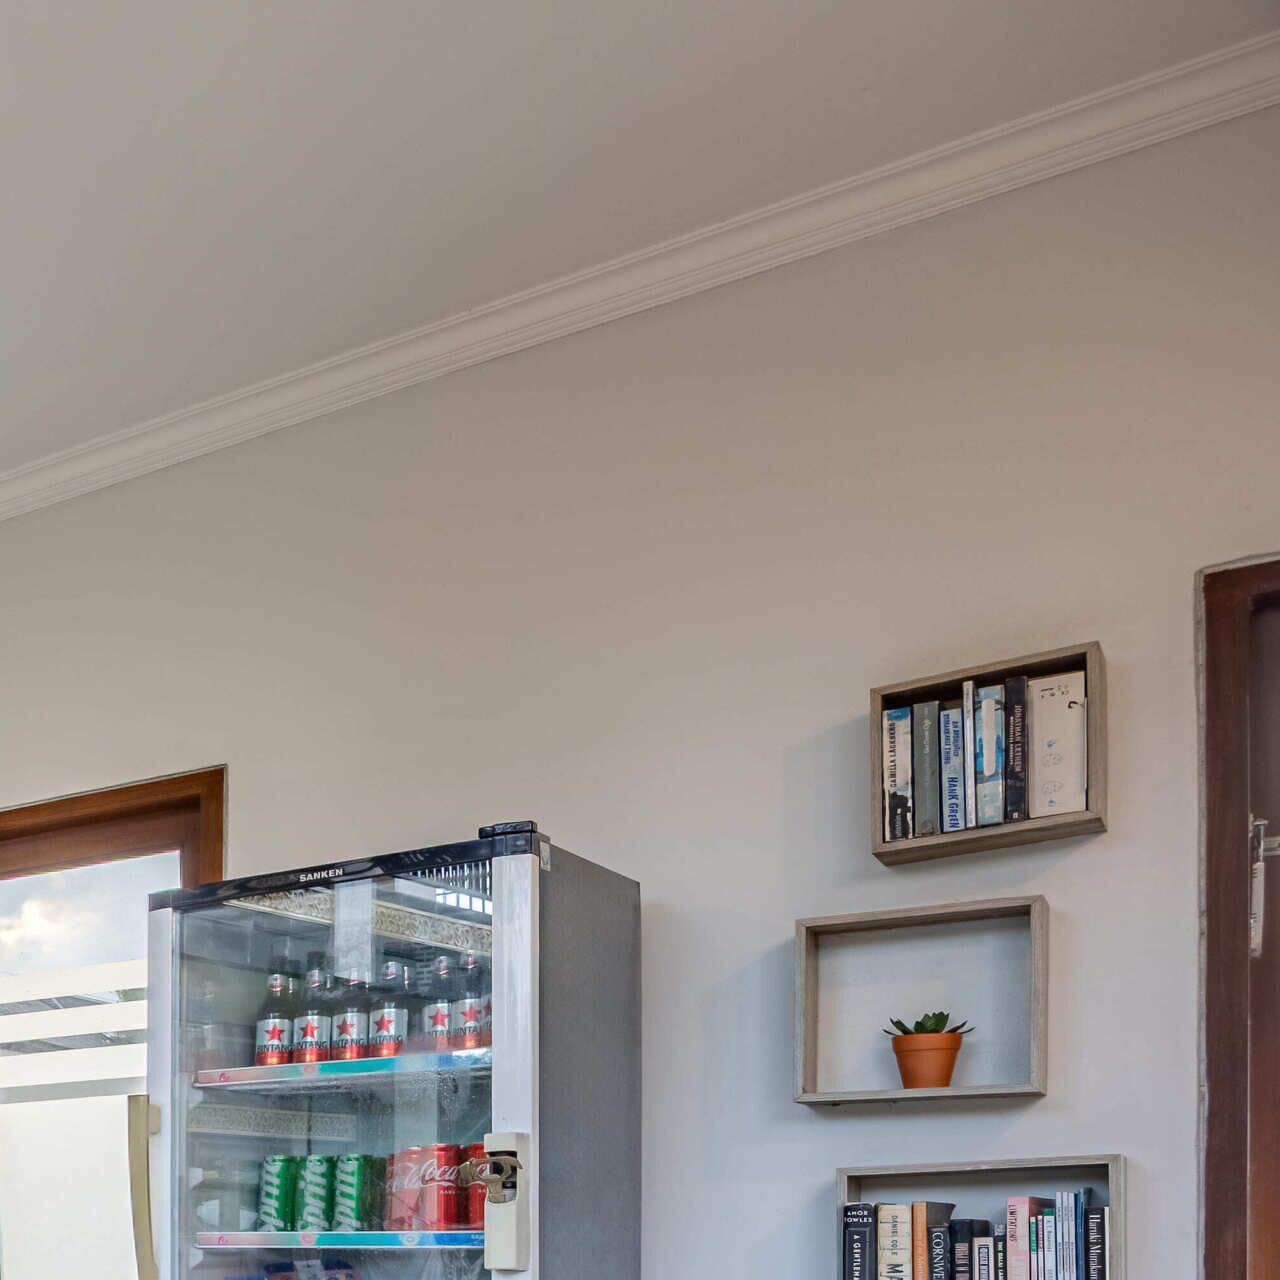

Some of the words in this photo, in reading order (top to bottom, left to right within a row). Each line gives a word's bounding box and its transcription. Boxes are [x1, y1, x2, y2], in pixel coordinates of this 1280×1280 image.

[1014, 705, 1023, 741] JONATHAN
[947, 777, 959, 800] HANK
[947, 803, 960, 829] GREEN
[299, 868, 344, 883] SANKEN
[1008, 1204, 1017, 1242] LIMITATIONS
[1089, 1215, 1102, 1242] Haruki
